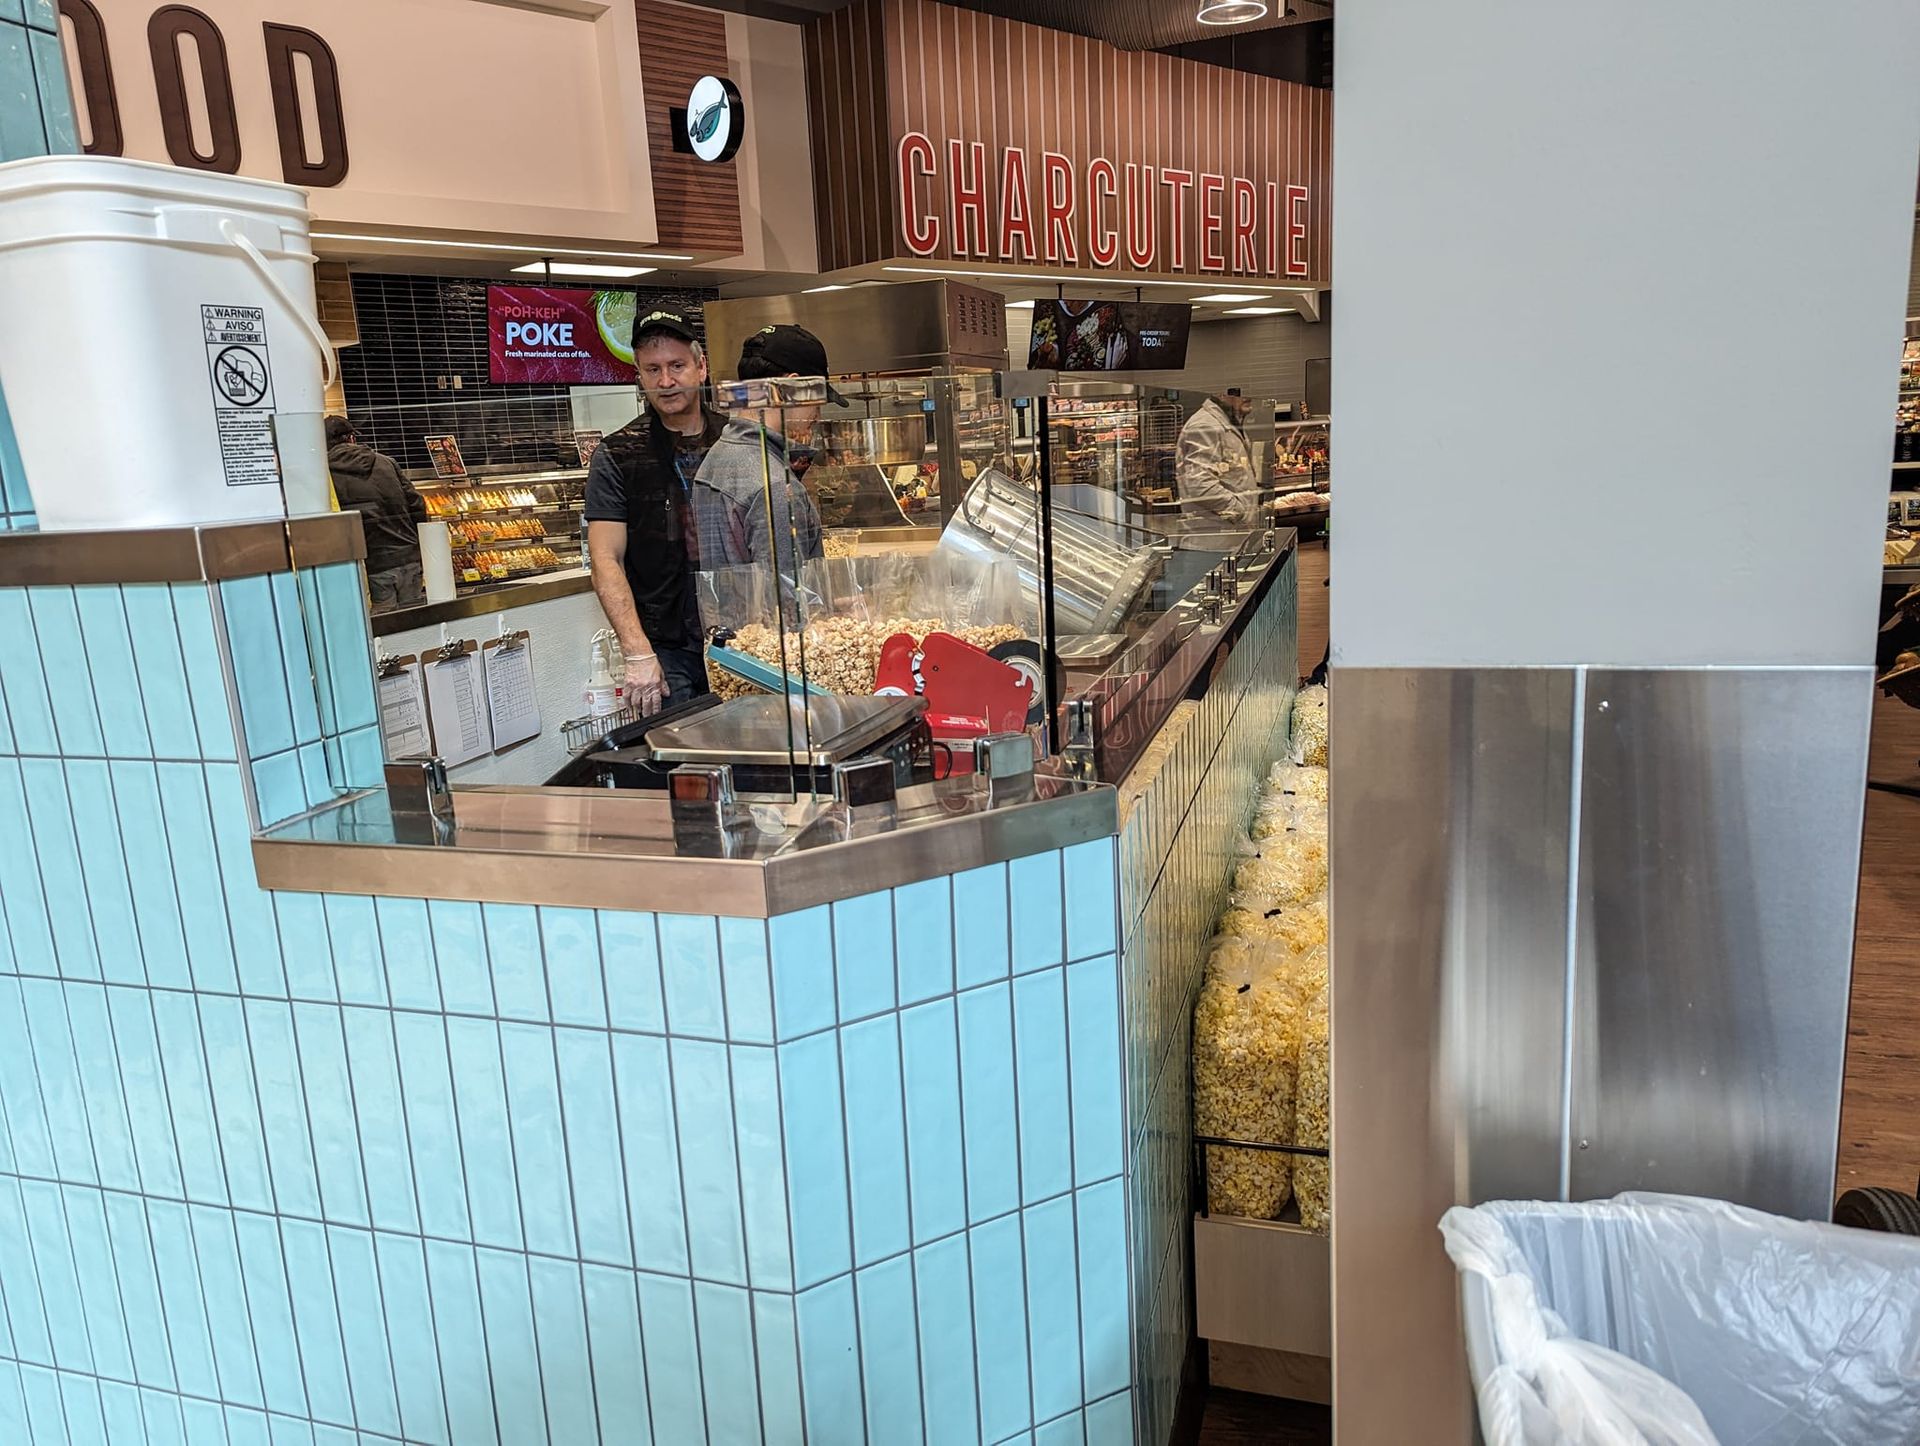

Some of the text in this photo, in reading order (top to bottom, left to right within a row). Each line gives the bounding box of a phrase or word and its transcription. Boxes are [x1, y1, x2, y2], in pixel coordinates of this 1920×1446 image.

[897, 131, 1308, 276] CHARCUTERIE
[214, 308, 261, 320] WARNING
[225, 320, 255, 331] AVISO
[506, 322, 574, 346] POKE
[505, 350, 591, 358] Fresh marinated cuts of fish.
